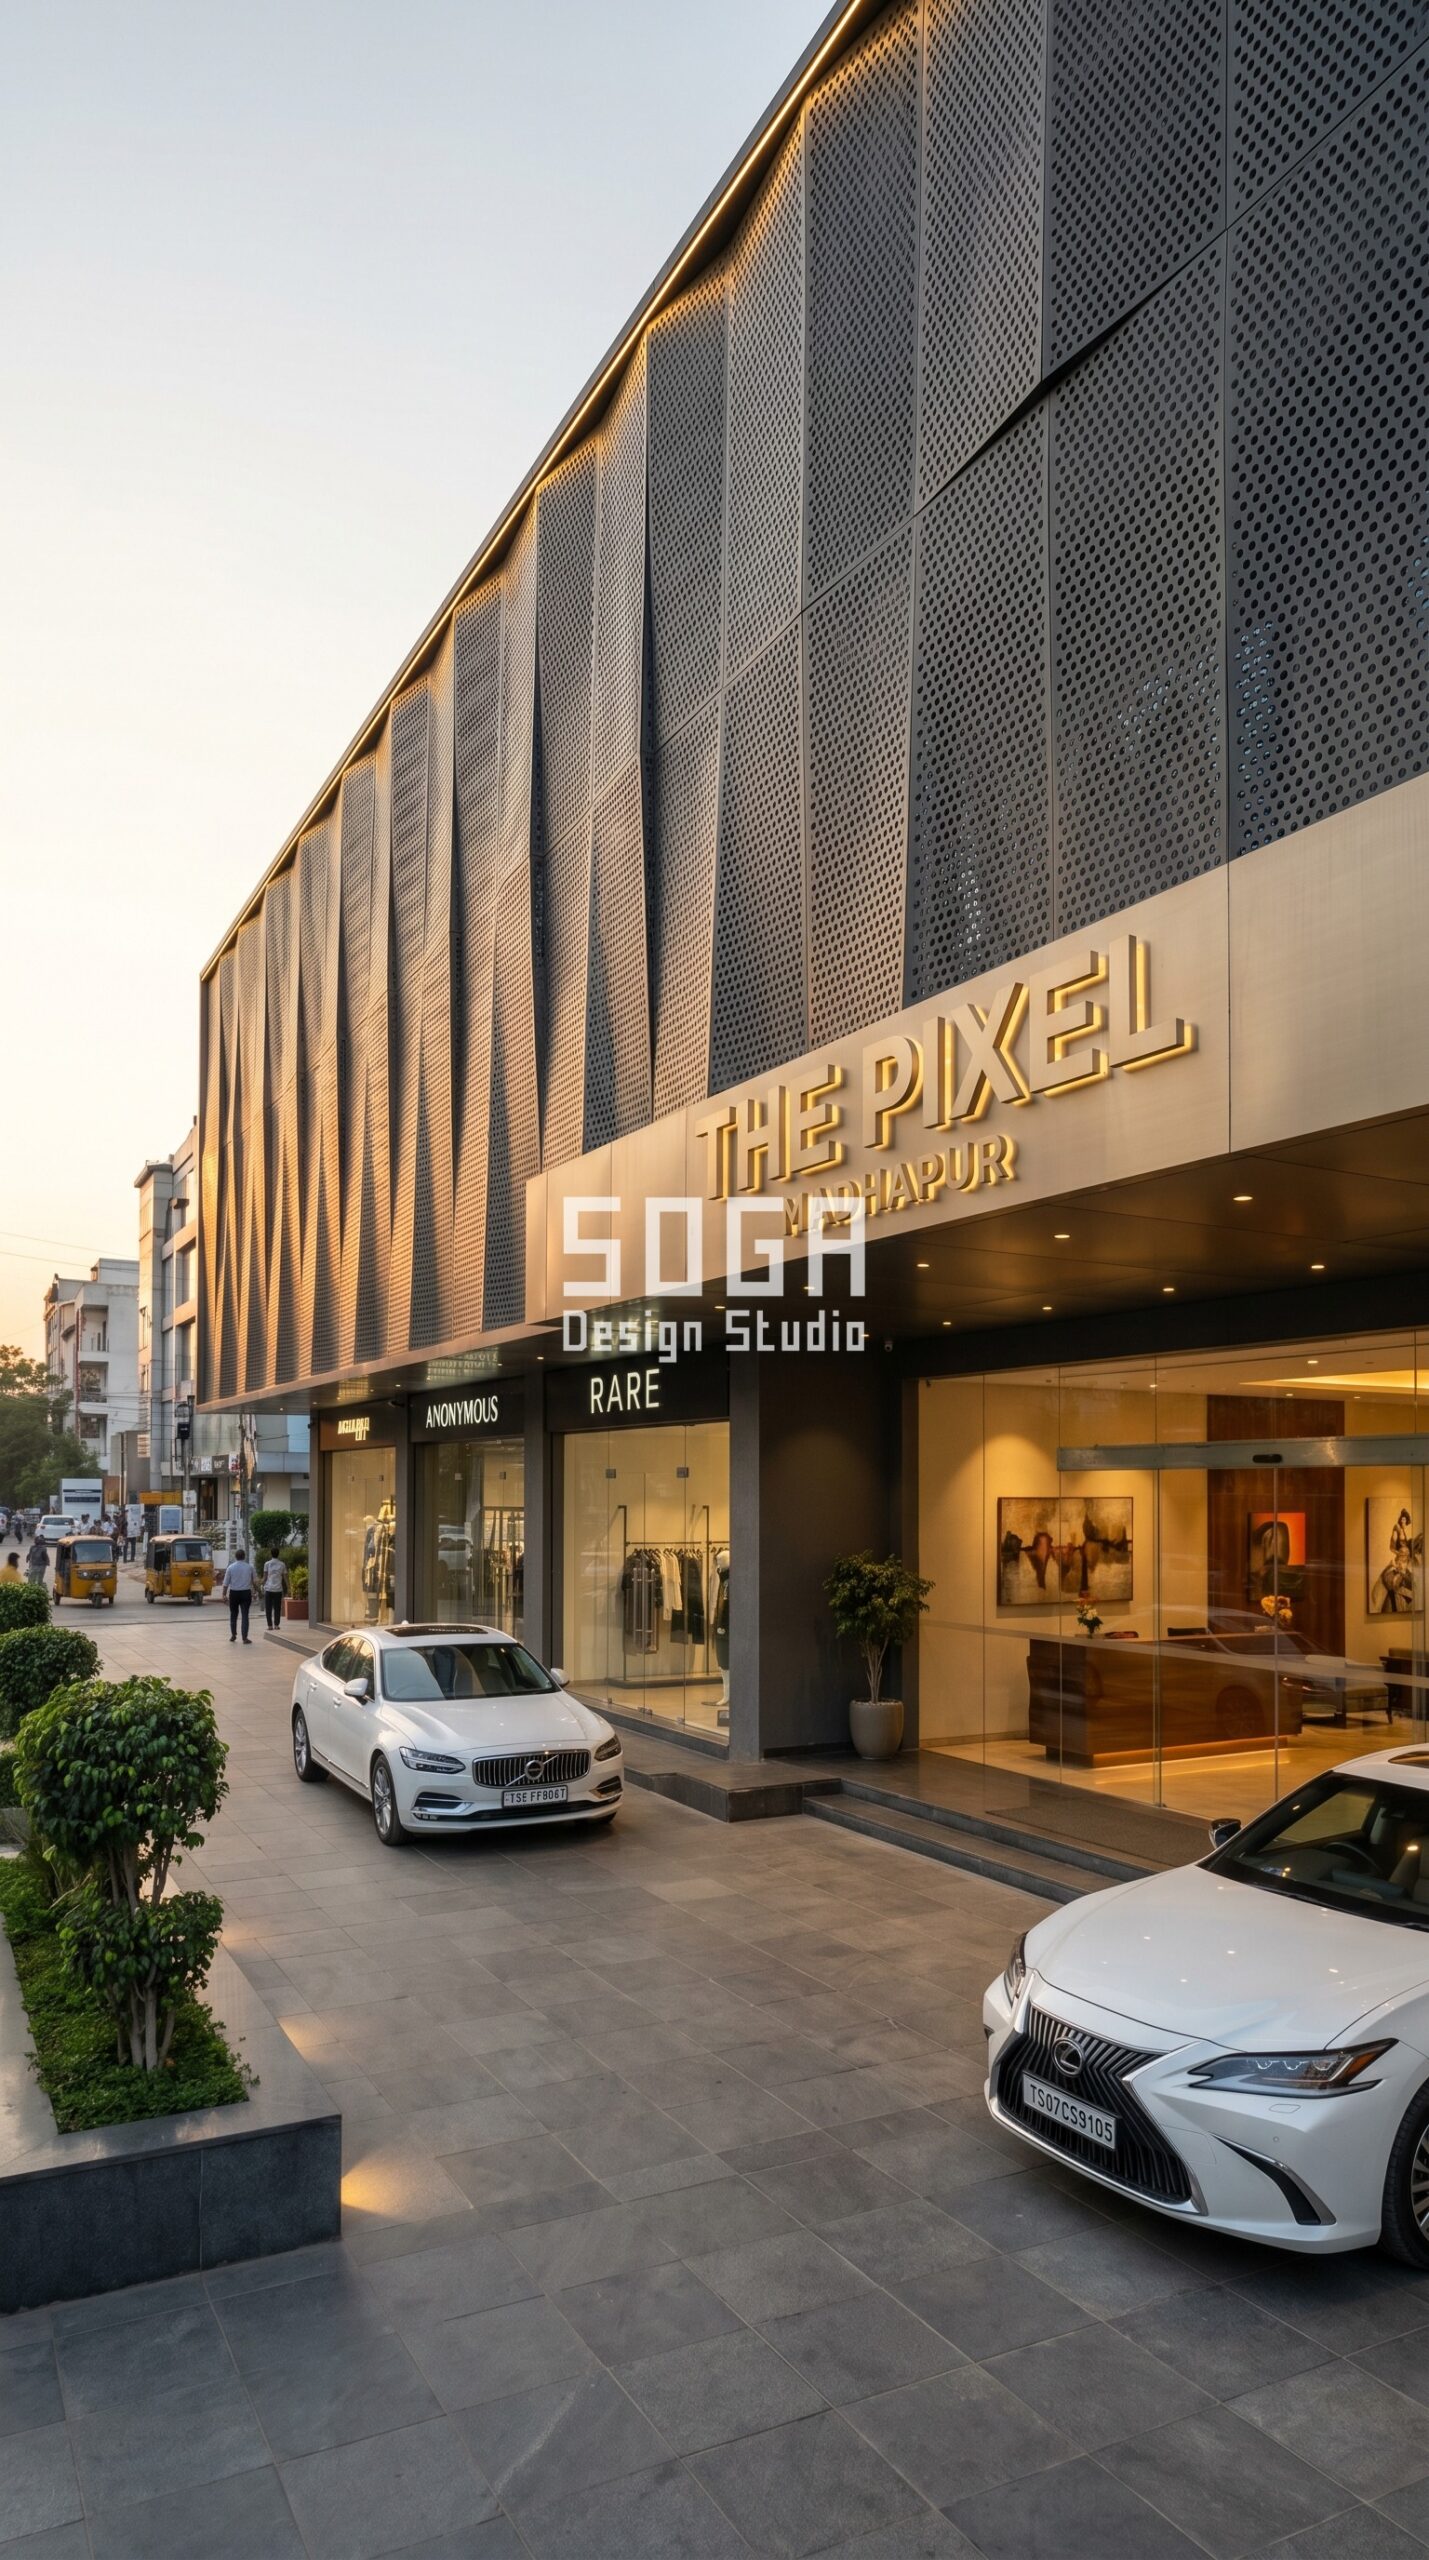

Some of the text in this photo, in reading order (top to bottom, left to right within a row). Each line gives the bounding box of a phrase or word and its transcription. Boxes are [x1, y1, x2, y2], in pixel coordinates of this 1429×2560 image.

[697, 934, 1195, 1201] THE PIXEL
[784, 1134, 1017, 1237] MADHAPUR
[426, 1395, 499, 1428] ANONYMOUS
[590, 1368, 660, 1414] RARE
[1030, 2084, 1113, 2142] TS07CS9105
